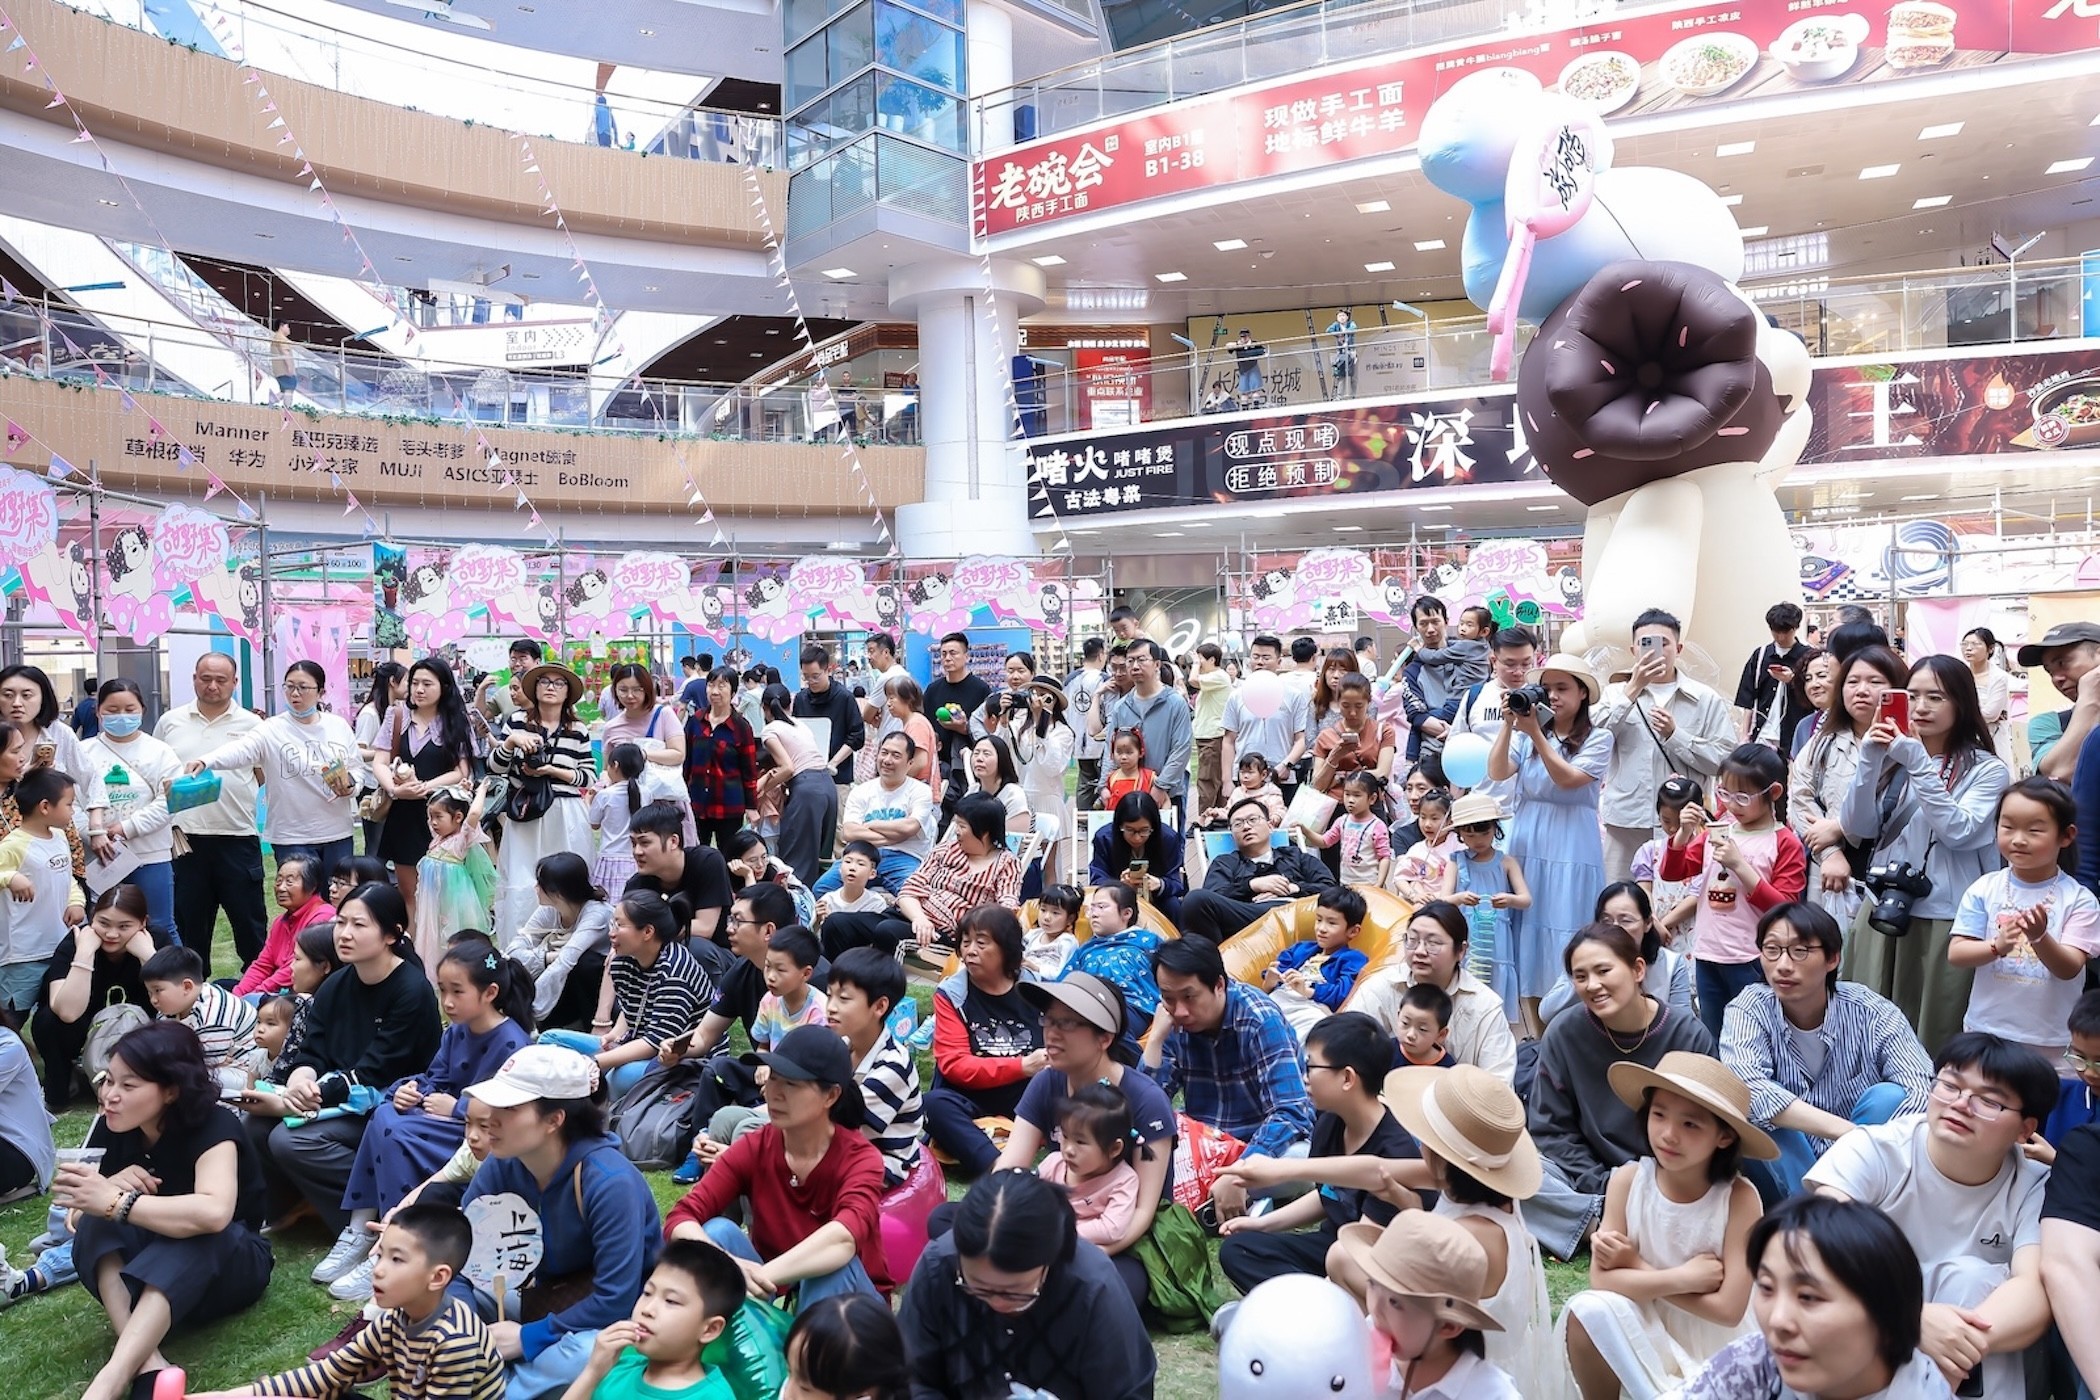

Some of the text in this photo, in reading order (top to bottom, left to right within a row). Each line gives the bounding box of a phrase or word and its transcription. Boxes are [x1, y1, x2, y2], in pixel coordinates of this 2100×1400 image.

[1264, 81, 1405, 129] 现做手工面
[1264, 107, 1407, 155] 地标鲜牛羊
[989, 142, 1114, 210] 老碗会
[1144, 149, 1206, 178] B1-38
[1016, 192, 1089, 223] 陕西手工面
[506, 330, 536, 344] 室内
[195, 421, 270, 442] Manner
[292, 430, 379, 454] 星巴克臻选
[1229, 426, 1335, 456] 现点现啫
[229, 449, 266, 469] 华为
[288, 456, 359, 476] 小米之家
[380, 461, 423, 479] MUJI
[558, 472, 630, 489] BoBloom
[1036, 445, 1110, 487] 啫火
[1113, 444, 1174, 467] 啫啫煲
[1113, 463, 1174, 479] JUST FIRE
[1229, 461, 1335, 490] 拒绝预制
[1064, 483, 1142, 512] 古法粤菜
[496, 1210, 537, 1271] 上海
